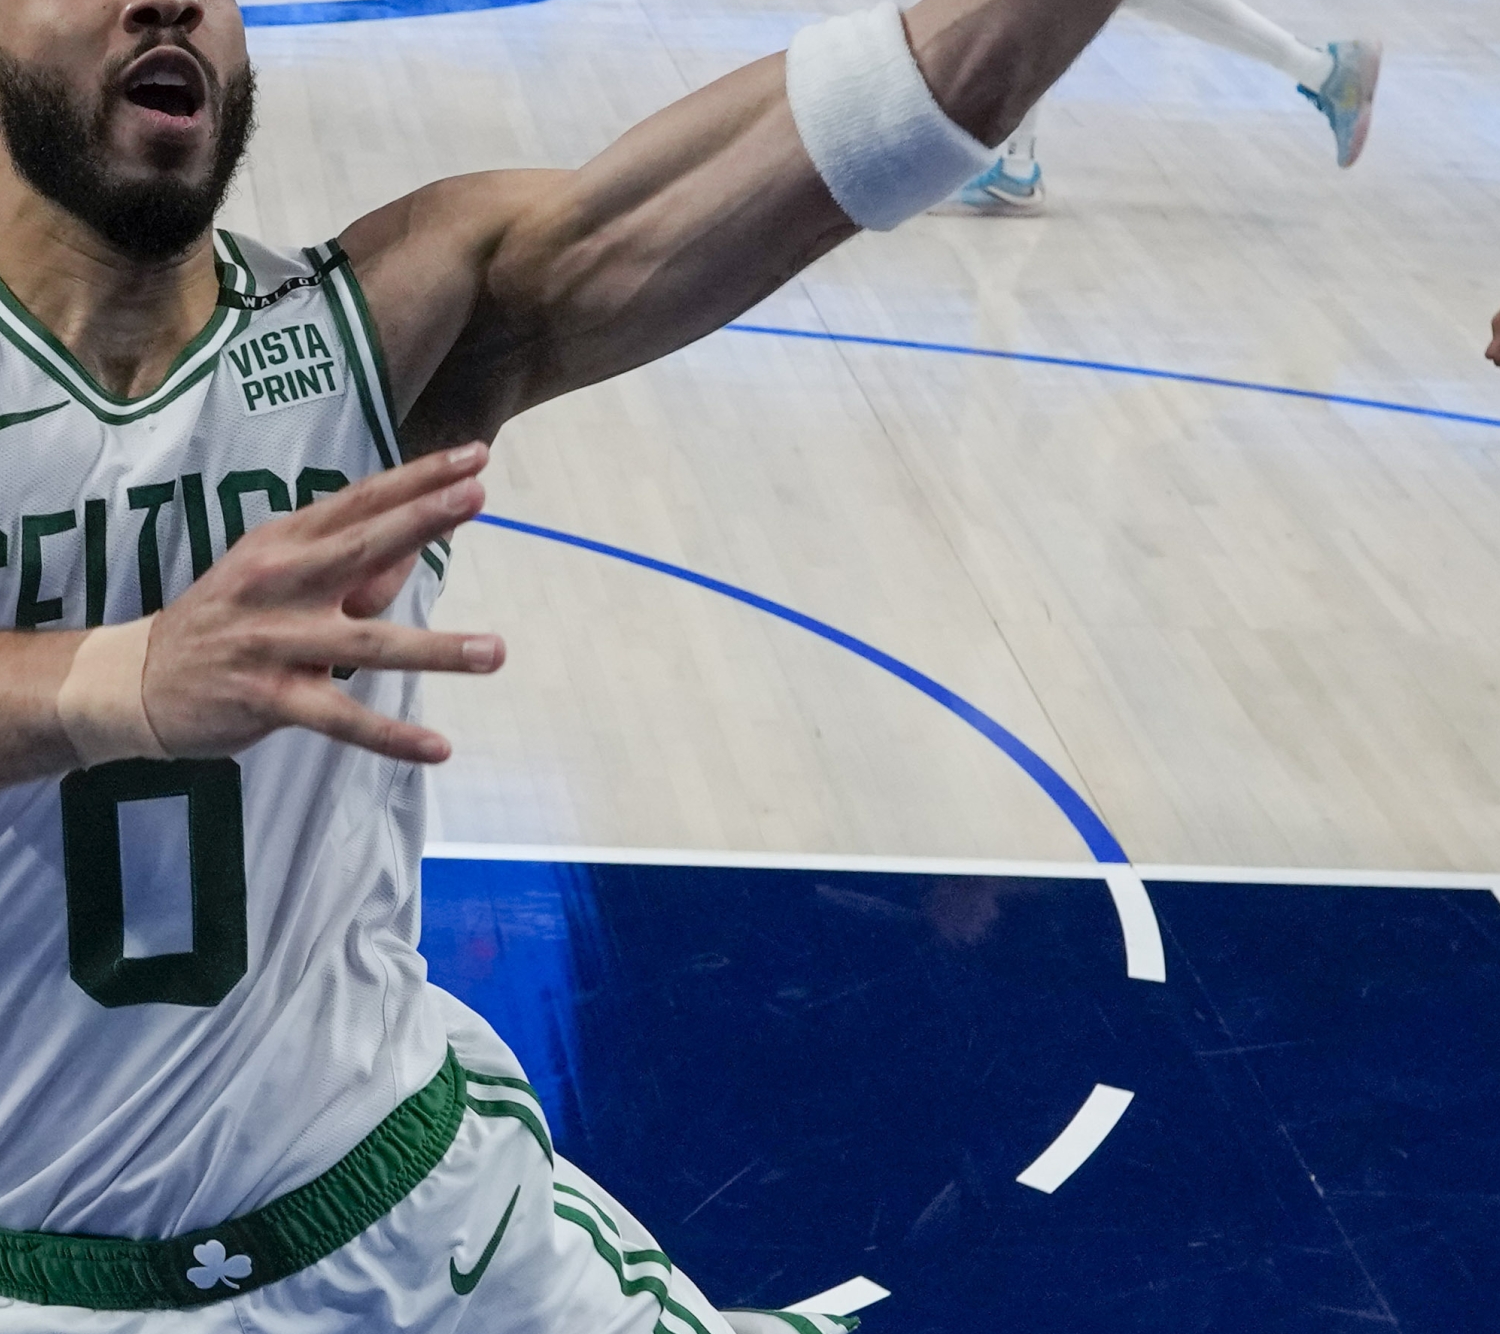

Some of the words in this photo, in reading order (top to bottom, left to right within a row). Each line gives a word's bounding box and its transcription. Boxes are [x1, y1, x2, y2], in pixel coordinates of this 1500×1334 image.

[228, 323, 332, 379] VISTA
[242, 361, 336, 411] PRINT
[59, 756, 249, 1008] 0
